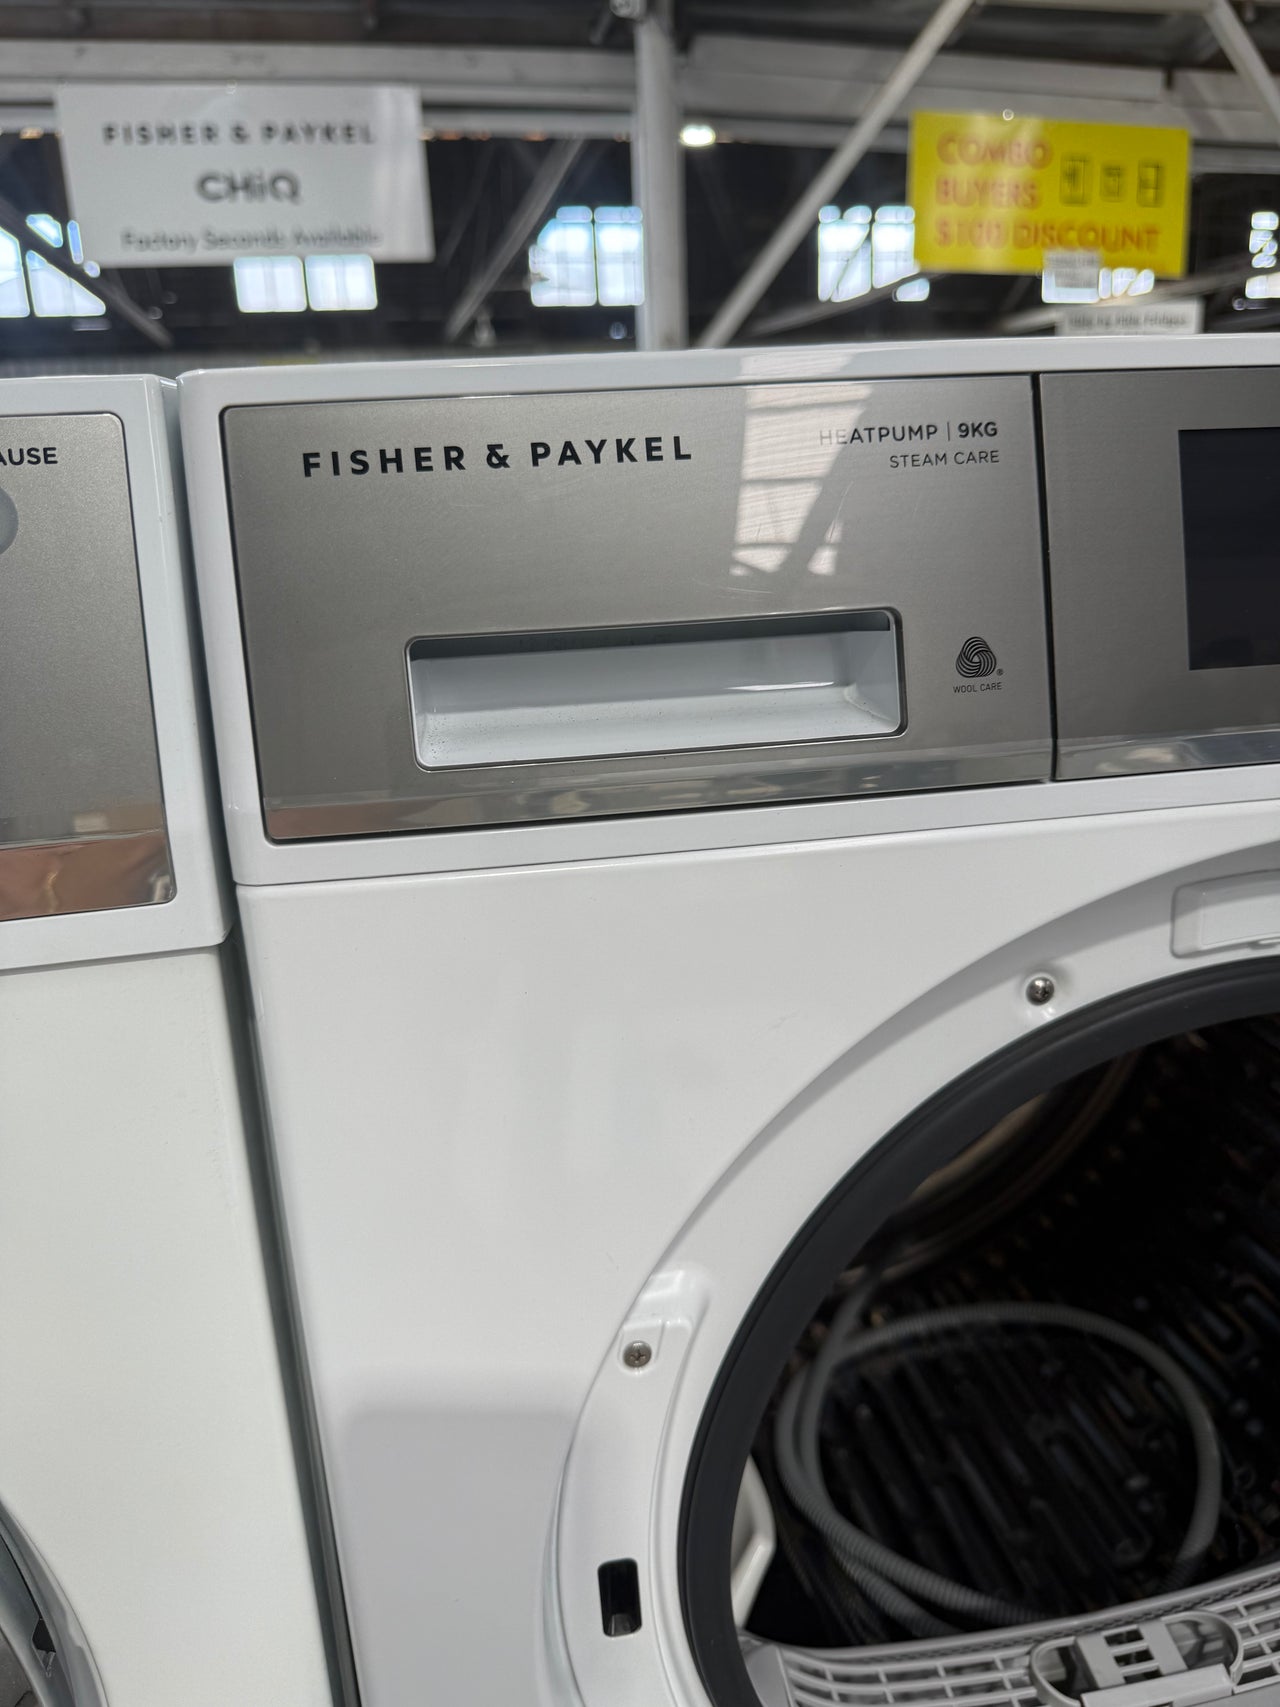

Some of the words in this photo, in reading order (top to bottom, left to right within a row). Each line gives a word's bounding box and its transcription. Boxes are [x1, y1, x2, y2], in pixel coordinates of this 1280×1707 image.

[102, 123, 219, 146] FISHER
[230, 122, 250, 144] &
[261, 122, 376, 145] PAYKEL
[936, 132, 1053, 170] COMBO
[935, 176, 1041, 210] BUYERS
[1013, 221, 1161, 254] DISCOUNT
[819, 424, 938, 446] HEATPUMP
[957, 421, 998, 439] 9KG
[302, 445, 466, 477] FISHER
[486, 443, 511, 468] &
[530, 435, 692, 467] PAYKEL
[889, 452, 947, 469] STEAM
[953, 450, 1000, 465] CARE
[953, 684, 978, 693] WOOL
[980, 682, 1002, 692] CARE
